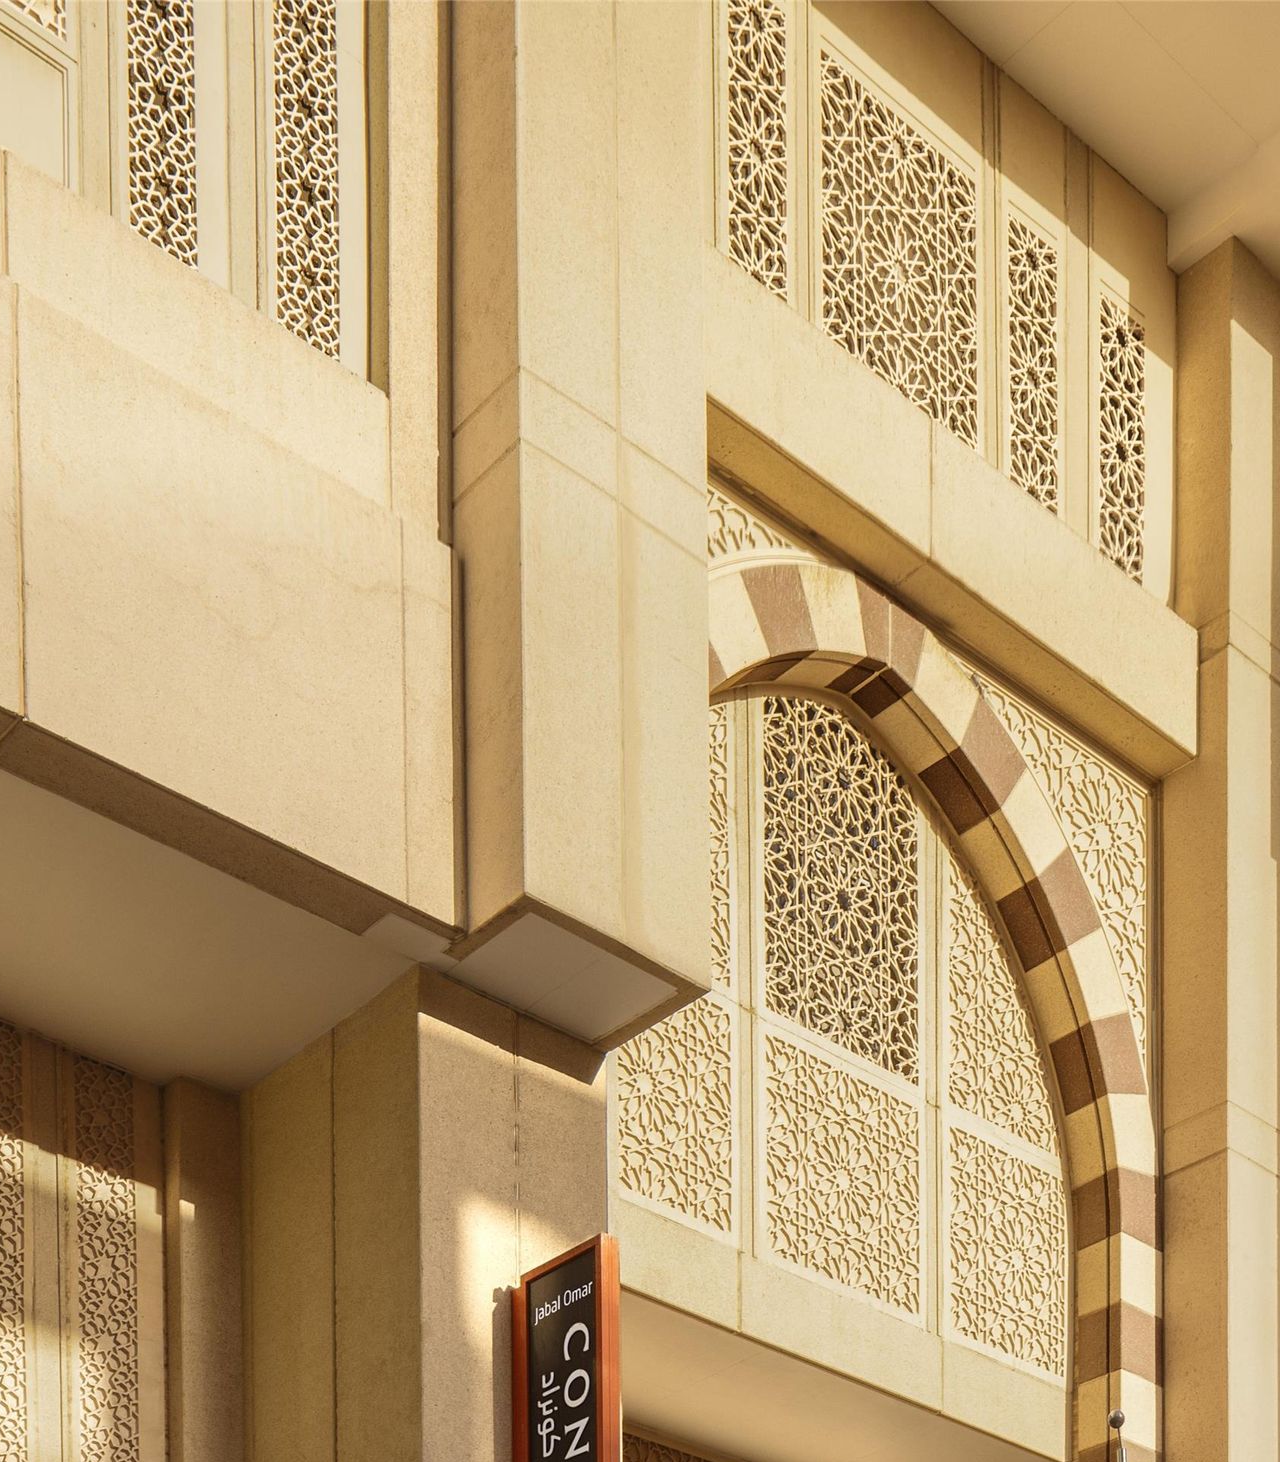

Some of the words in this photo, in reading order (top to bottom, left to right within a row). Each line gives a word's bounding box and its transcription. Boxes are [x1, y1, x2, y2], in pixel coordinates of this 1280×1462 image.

[534, 1294, 562, 1326] Jabal
[563, 1281, 594, 1307] Omar
[537, 1370, 562, 1459] كونراد
